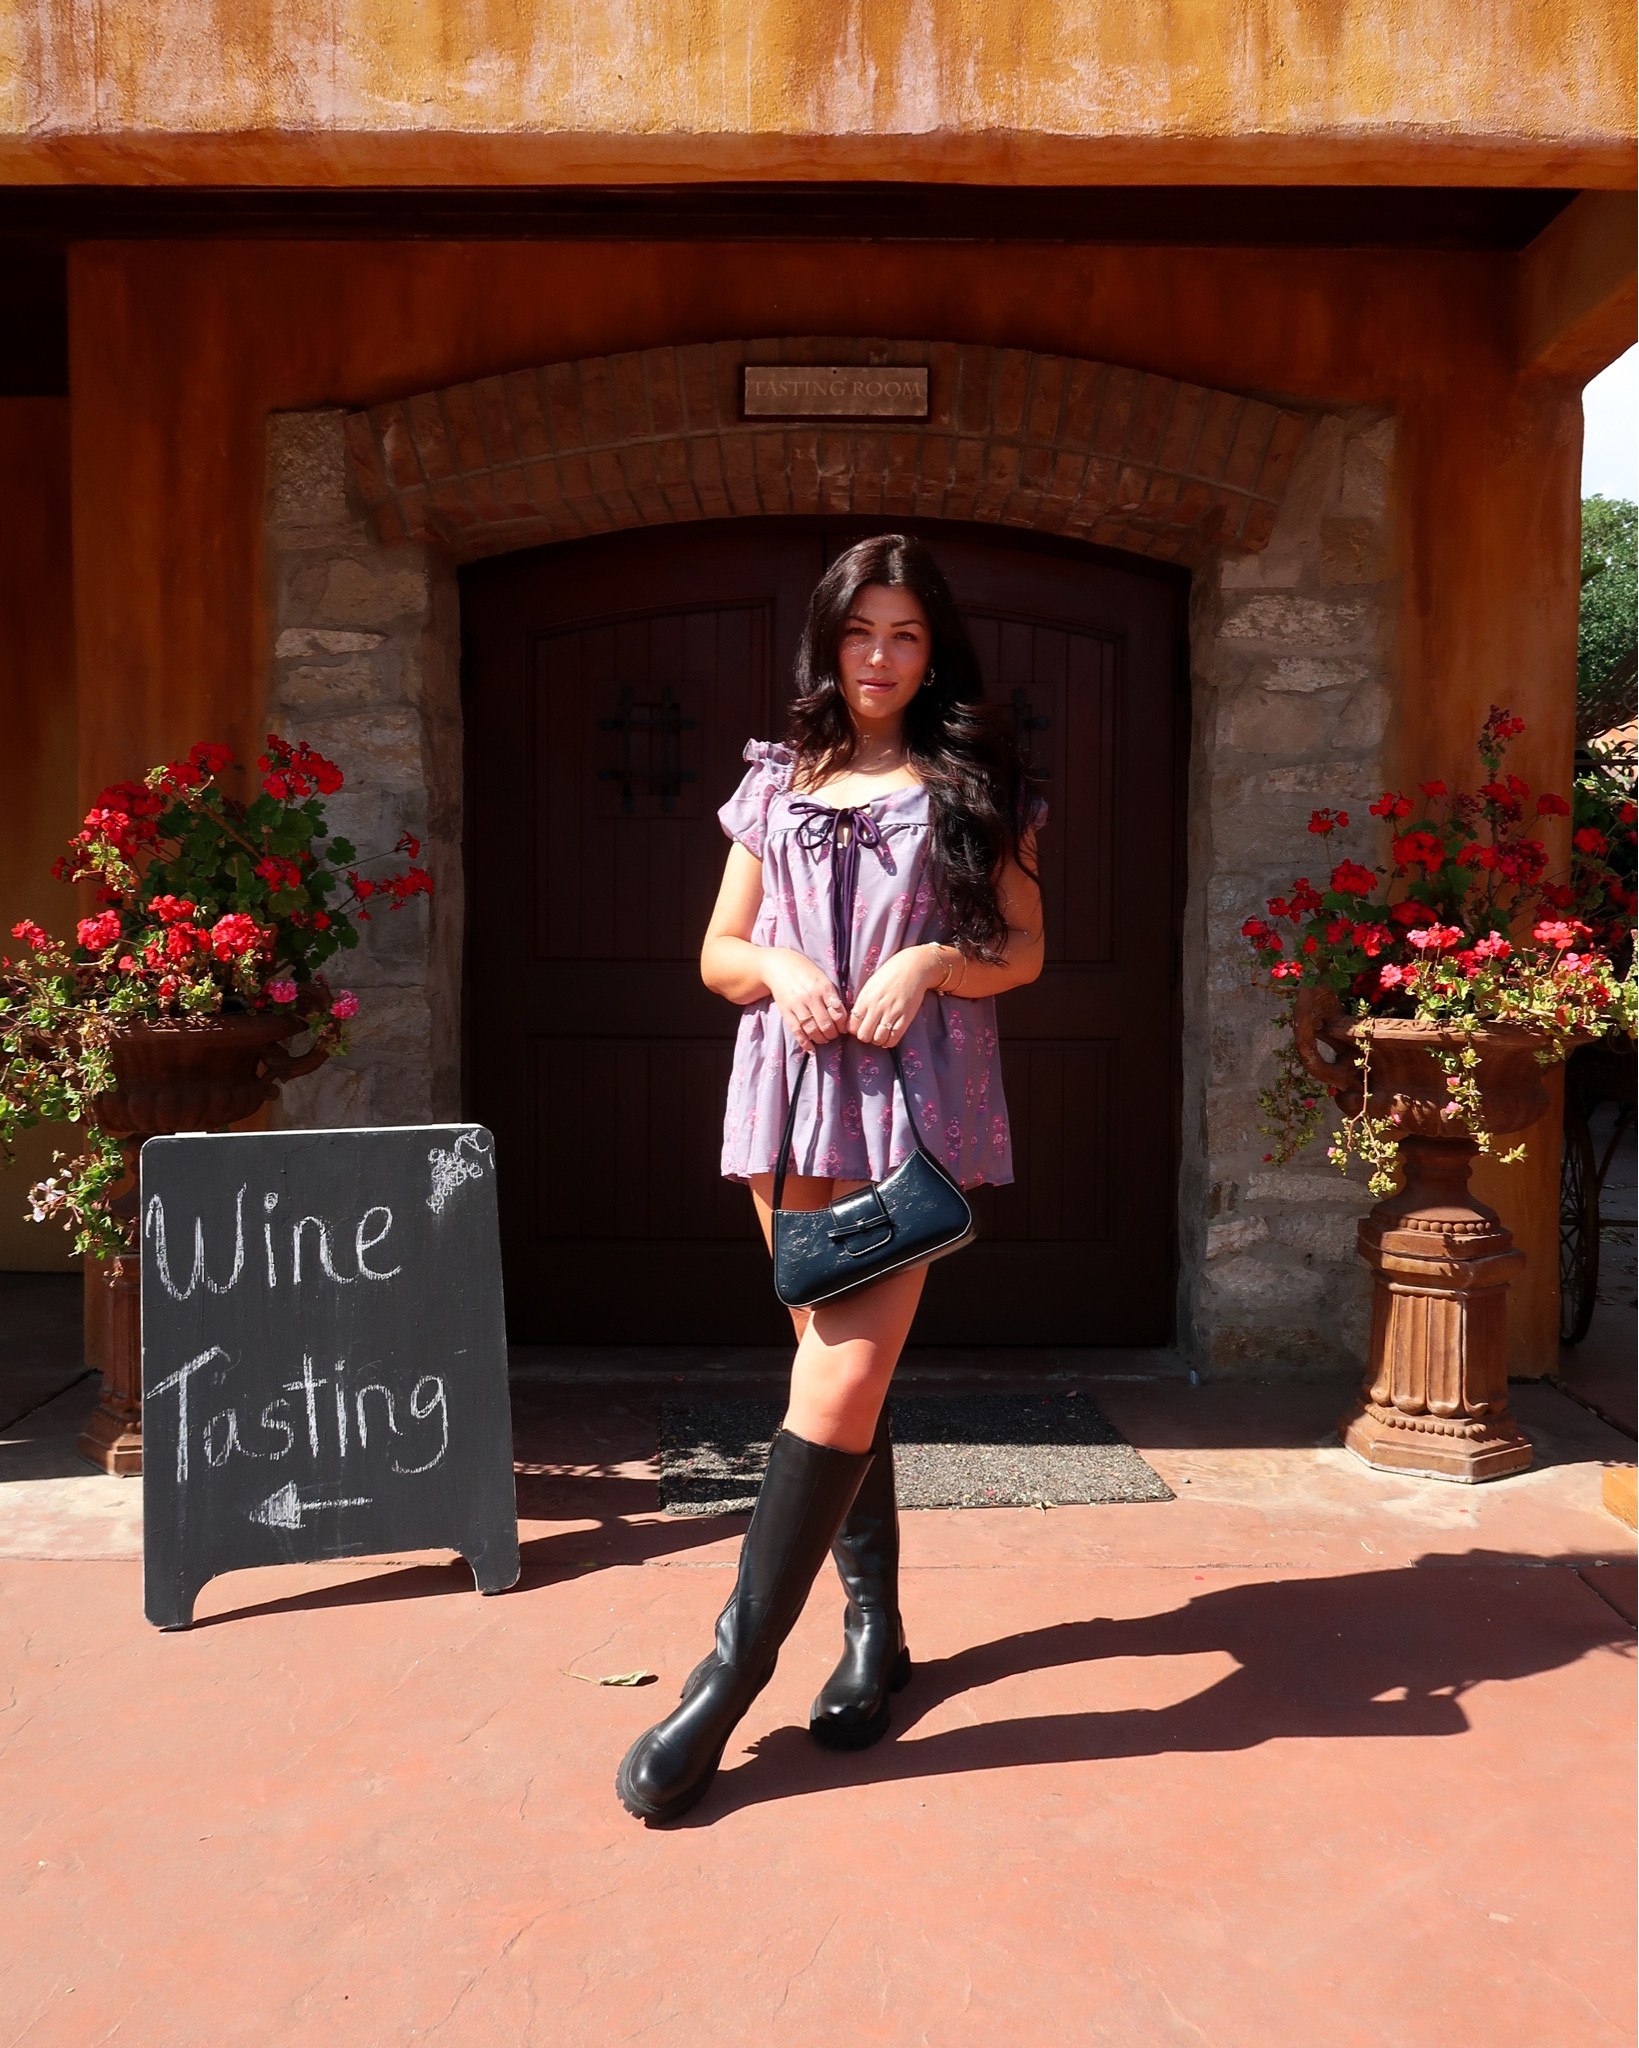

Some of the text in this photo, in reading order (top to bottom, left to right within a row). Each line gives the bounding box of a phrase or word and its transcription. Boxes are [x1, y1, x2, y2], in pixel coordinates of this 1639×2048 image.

[750, 380, 922, 398] TASTING ROOM
[145, 1182, 402, 1301] Wine
[145, 1344, 449, 1483] Tasting
